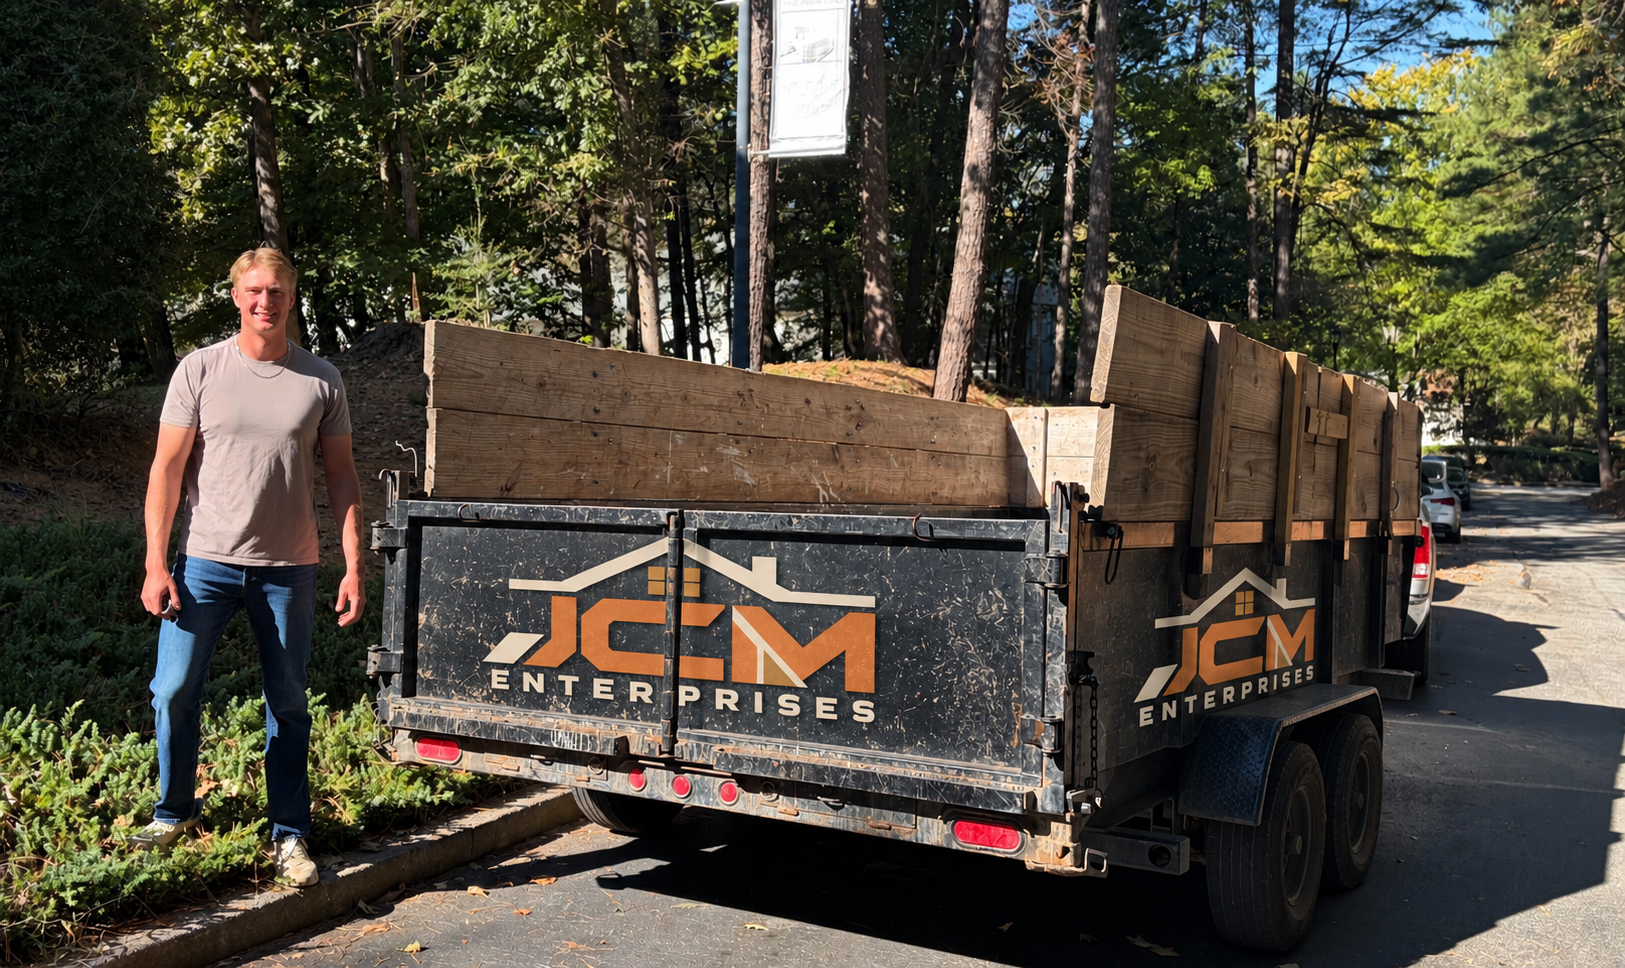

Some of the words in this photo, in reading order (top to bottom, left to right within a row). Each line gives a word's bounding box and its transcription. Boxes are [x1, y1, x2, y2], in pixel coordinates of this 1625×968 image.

[523, 595, 876, 694] JCM
[1163, 608, 1316, 697] JCM
[491, 668, 876, 723] ENTERPRISES
[1139, 665, 1314, 728] ENTERPRISES
